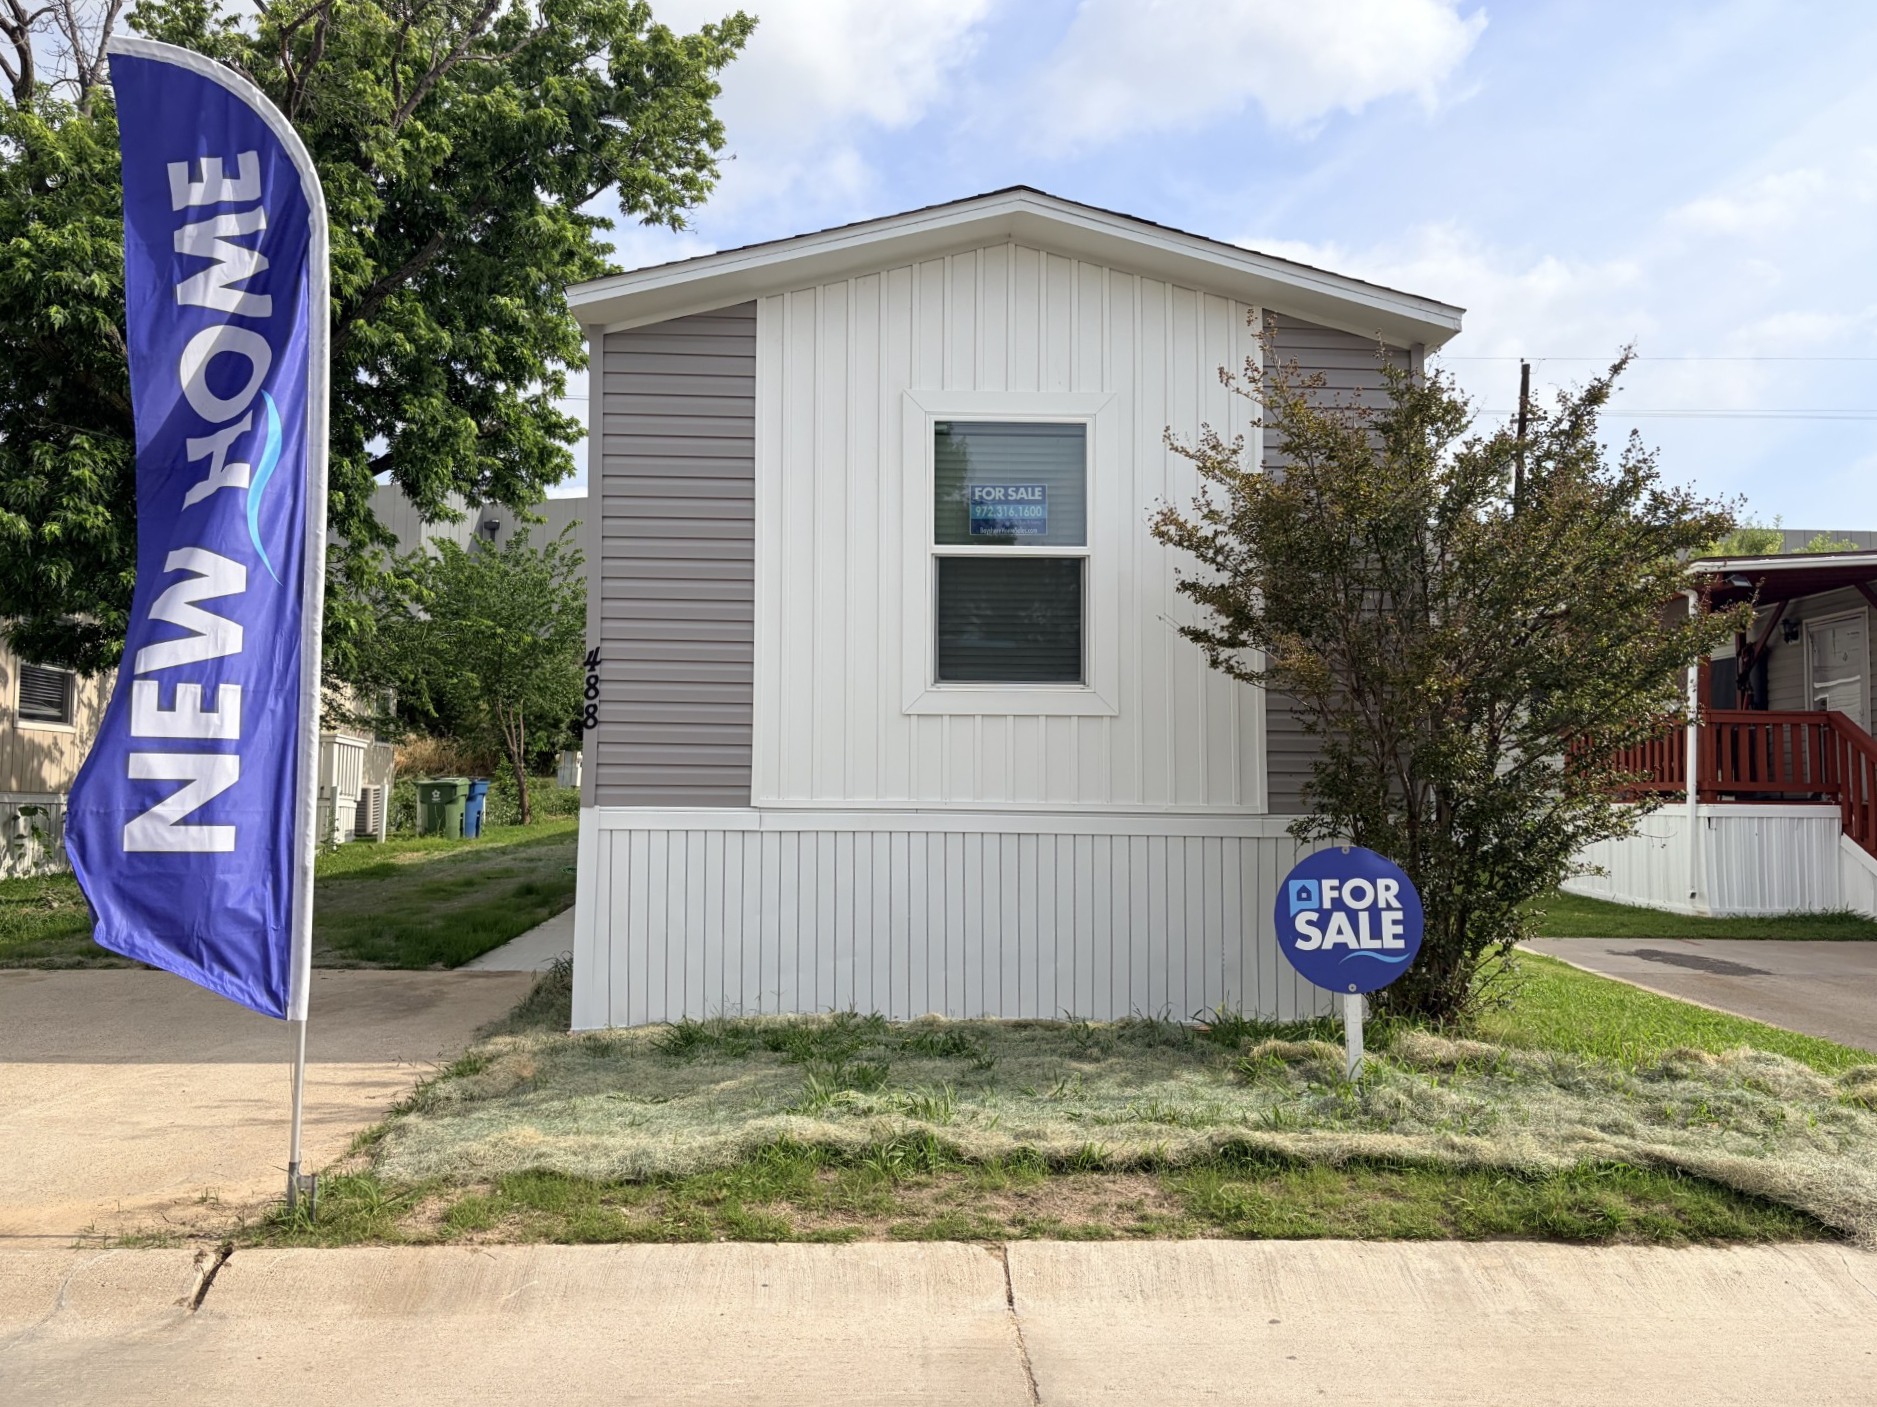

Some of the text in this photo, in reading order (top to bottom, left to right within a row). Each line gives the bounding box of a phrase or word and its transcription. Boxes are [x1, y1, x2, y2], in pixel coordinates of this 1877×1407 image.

[123, 150, 272, 852] NEW HOME
[975, 487, 1042, 500] FOR SALE
[975, 506, 1042, 517] 972.316.1600
[583, 646, 602, 729] 488
[1321, 877, 1403, 910] FOR
[1294, 911, 1405, 951] SALE
